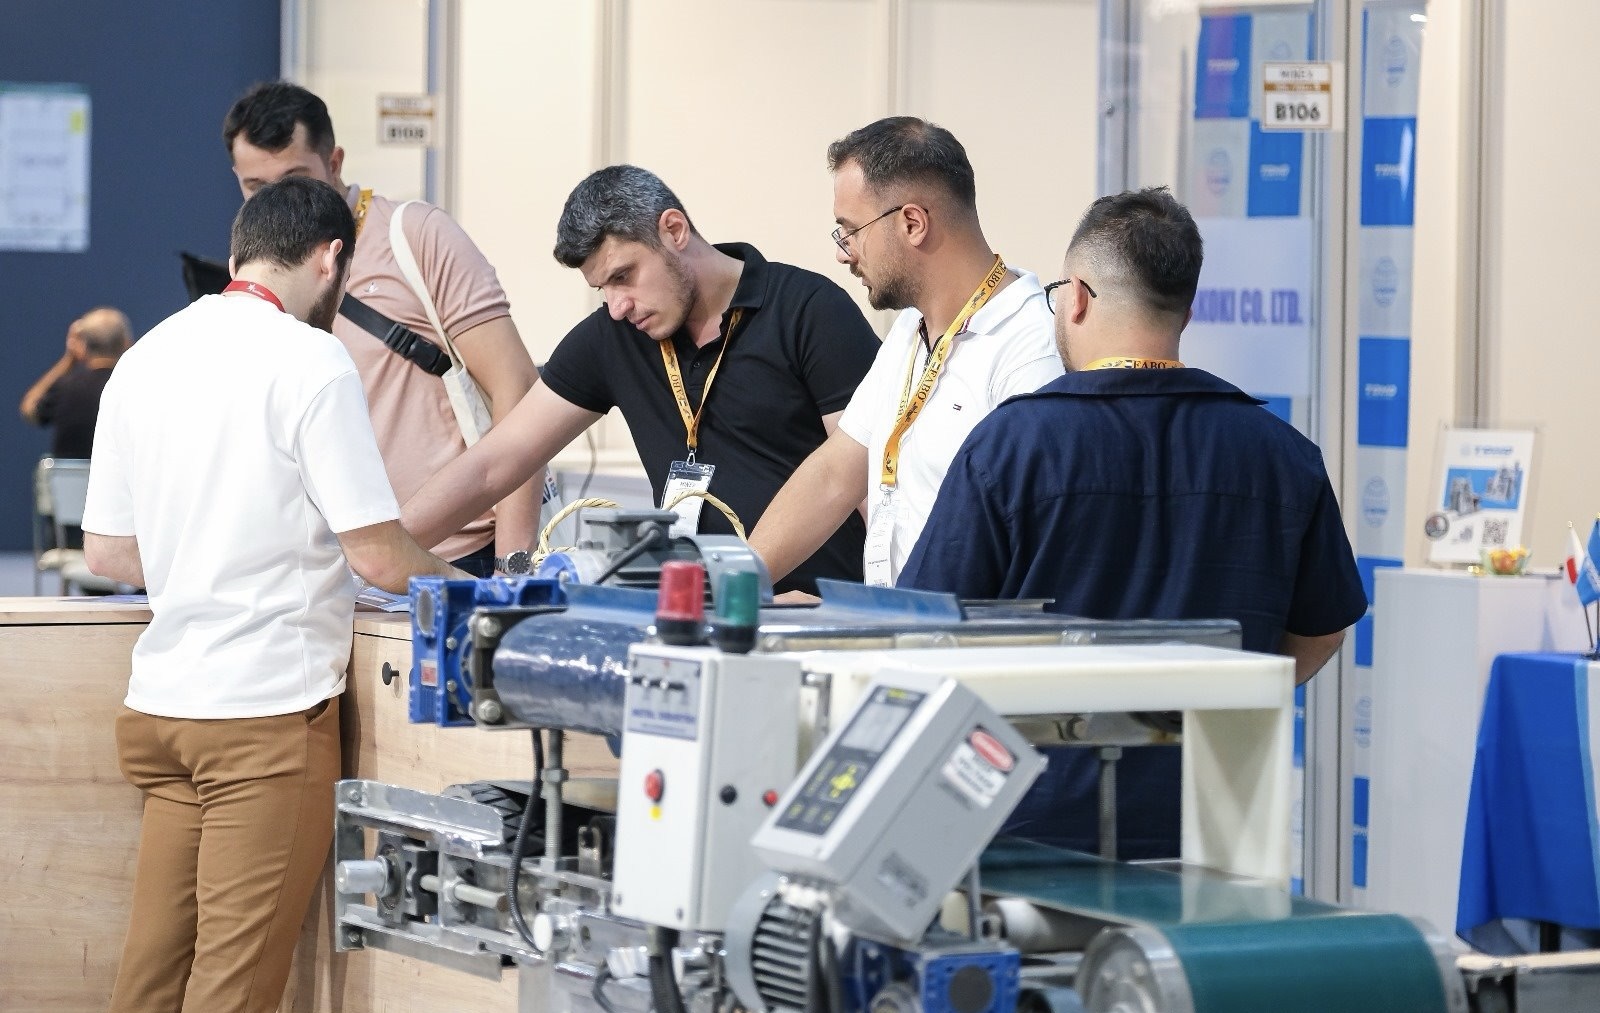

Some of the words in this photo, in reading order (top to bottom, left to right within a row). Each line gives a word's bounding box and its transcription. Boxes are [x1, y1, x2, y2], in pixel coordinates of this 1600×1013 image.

[1275, 103, 1320, 120] B106
[987, 261, 1006, 288] FABO
[1193, 289, 1235, 322] KOKI
[1241, 289, 1266, 324] CO.
[1270, 289, 1303, 324] LTD.
[1133, 360, 1165, 370] FABO
[917, 368, 937, 401] FABO
